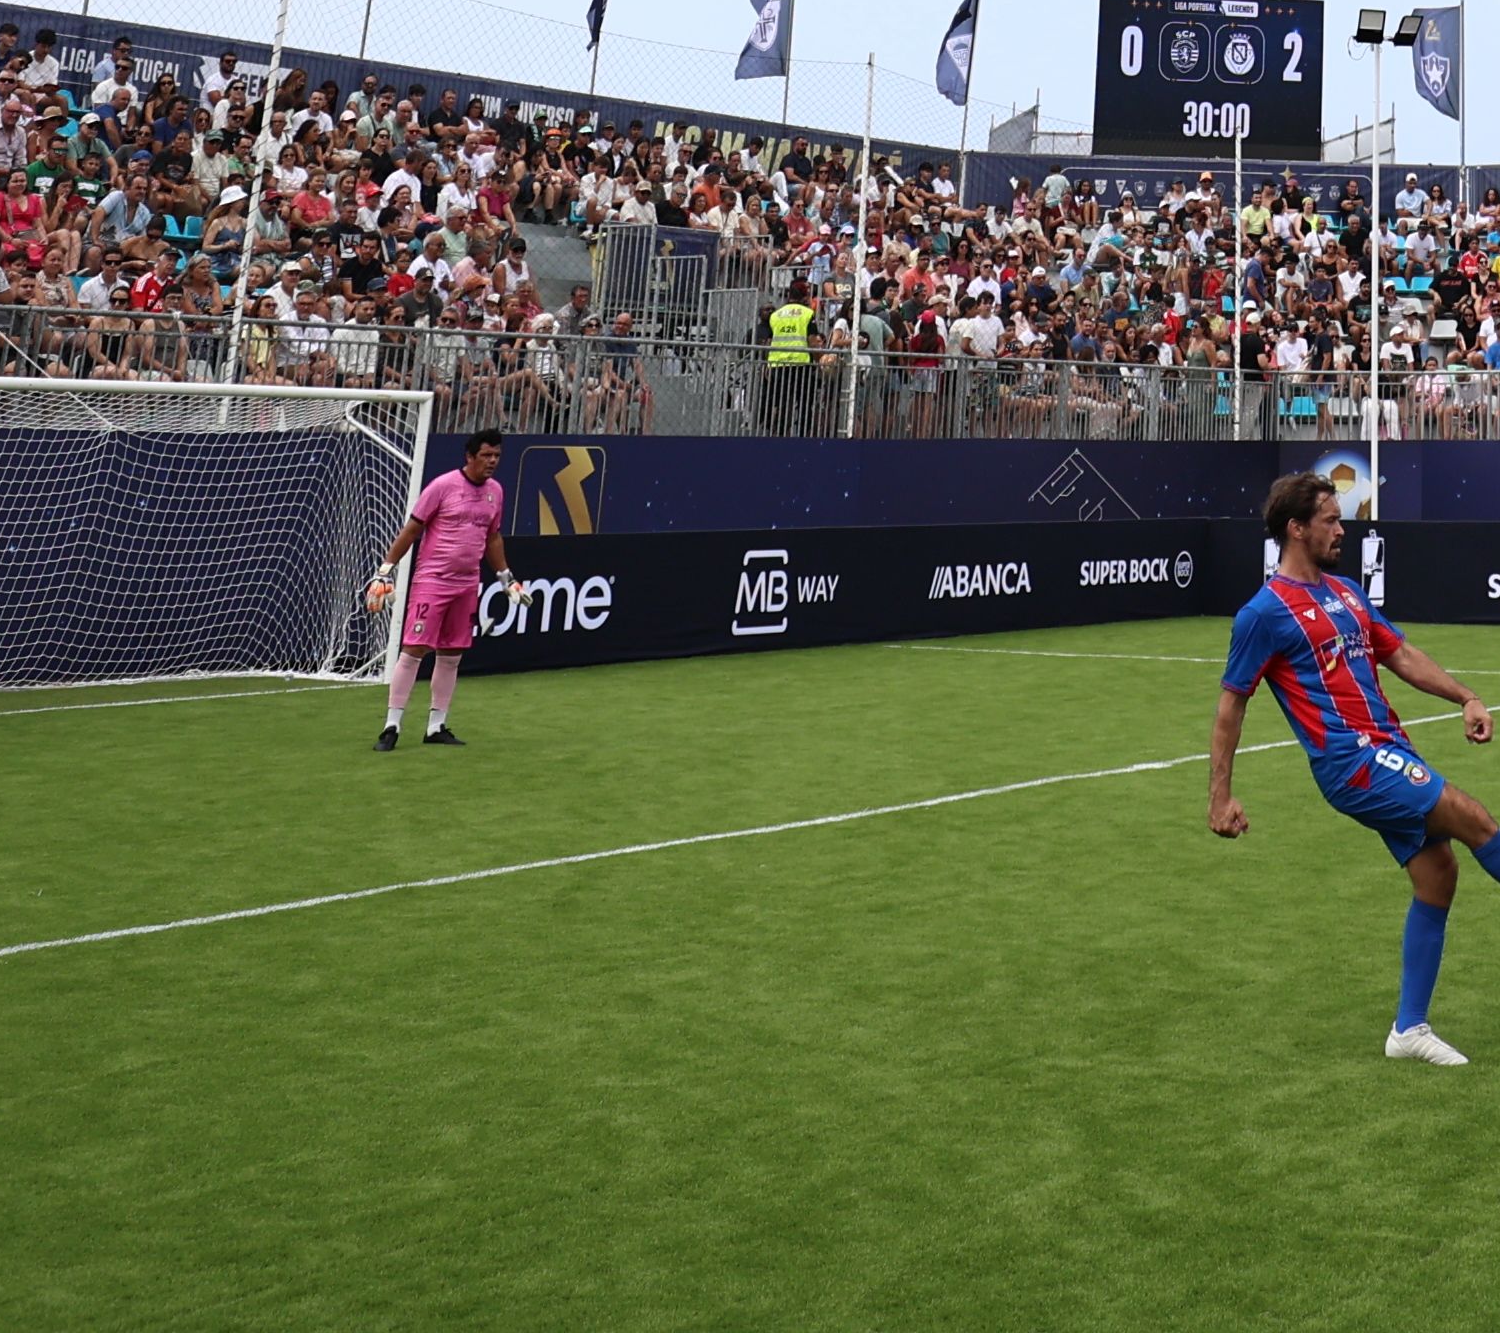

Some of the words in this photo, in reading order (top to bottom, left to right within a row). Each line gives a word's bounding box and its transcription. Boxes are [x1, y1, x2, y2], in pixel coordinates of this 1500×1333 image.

[1174, 1, 1187, 11] LIGA
[1188, 2, 1216, 12] PORTUGAL
[1228, 4, 1255, 14] LEGENDS
[59, 46, 95, 75] LIGA
[1120, 25, 1143, 76] 0
[1282, 32, 1303, 82] 2
[470, 93, 502, 120] UM
[1182, 101, 1250, 139] 30:00
[1080, 560, 1126, 586] SUPER
[1129, 558, 1169, 583] BOCK
[473, 576, 612, 637] ome
[734, 570, 788, 614] MB
[797, 574, 840, 603] WAY
[415, 602, 431, 620] 12
